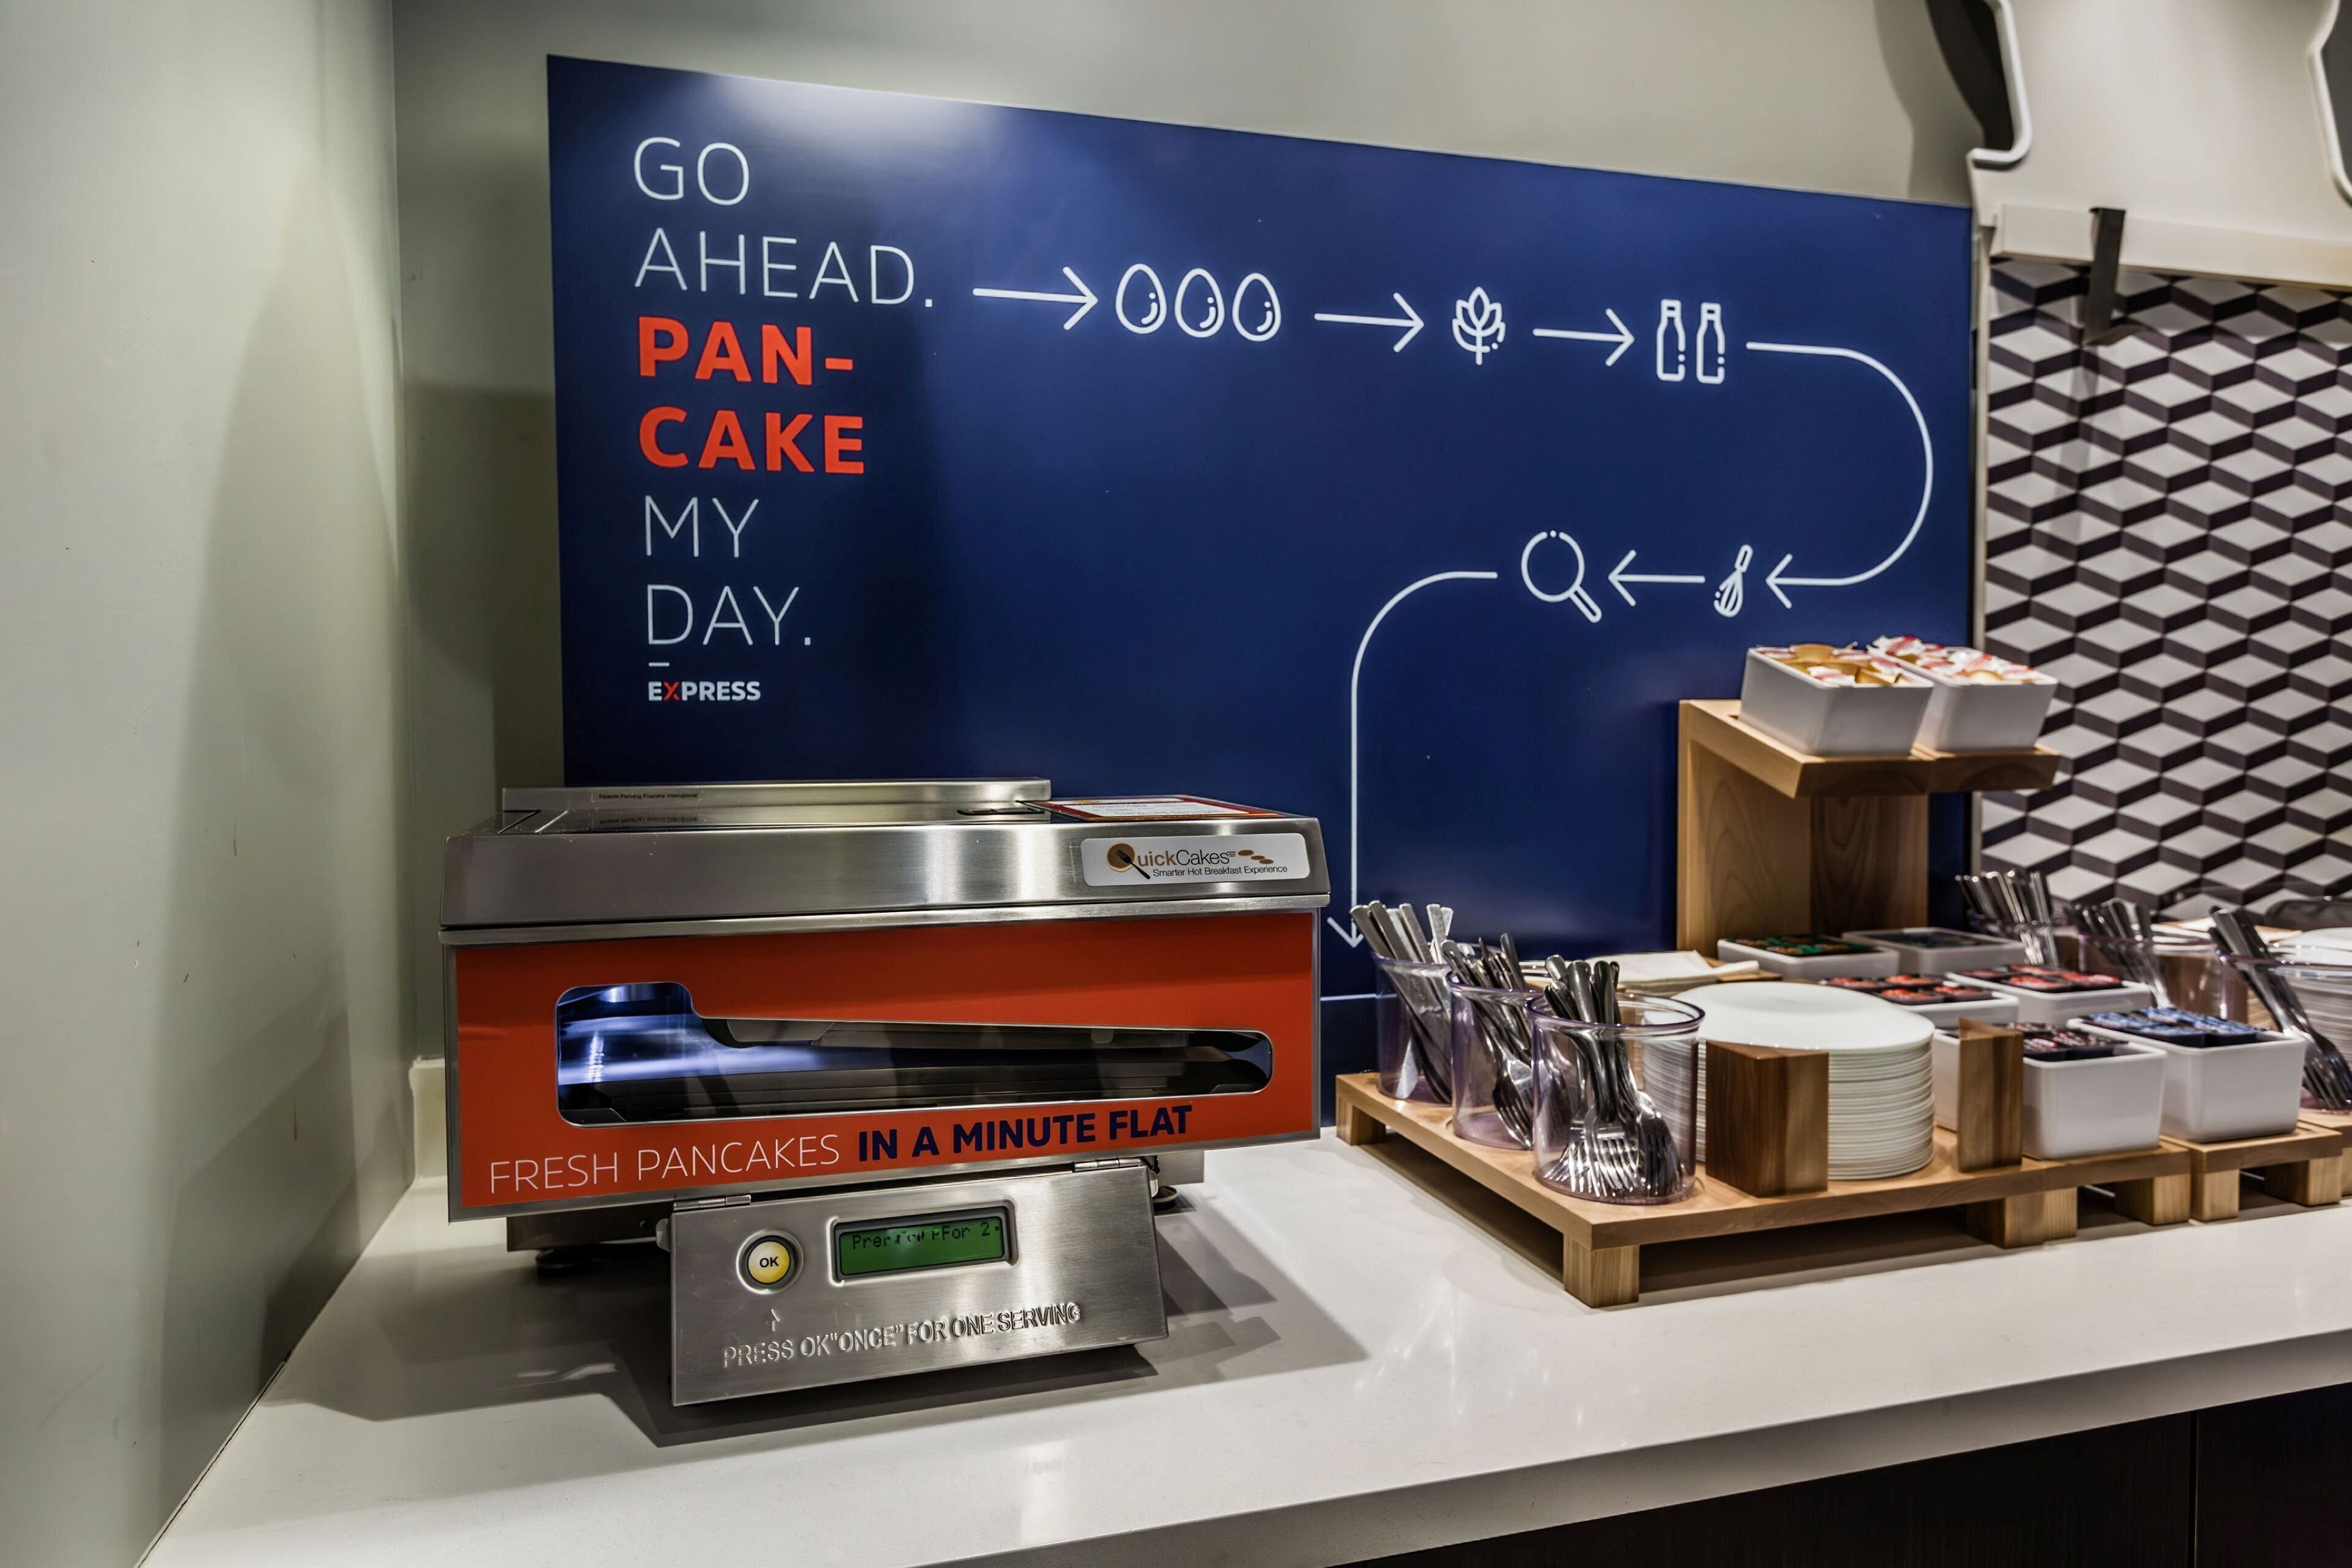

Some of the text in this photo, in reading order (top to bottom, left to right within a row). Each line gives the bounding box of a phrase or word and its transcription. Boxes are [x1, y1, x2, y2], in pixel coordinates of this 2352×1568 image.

[634, 137, 749, 205] GO
[635, 227, 933, 307] AHEAD.
[639, 316, 853, 385] PAN-
[639, 406, 864, 474] CAKE
[645, 495, 759, 557] MY
[647, 584, 812, 646] DAY.
[648, 680, 761, 701] EXPRESS
[1153, 869, 1185, 877] Smarter
[1205, 866, 1242, 875] Breakfast
[1245, 865, 1287, 874] Experience
[491, 1105, 1193, 1194] FRESH PANCAKES IN A MINUTE FLAT
[760, 1256, 779, 1268] OK
[723, 1340, 794, 1368] PRESS
[906, 1319, 948, 1345] FOR
[951, 1312, 995, 1338] ONE
[998, 1302, 1082, 1332] SERVING
